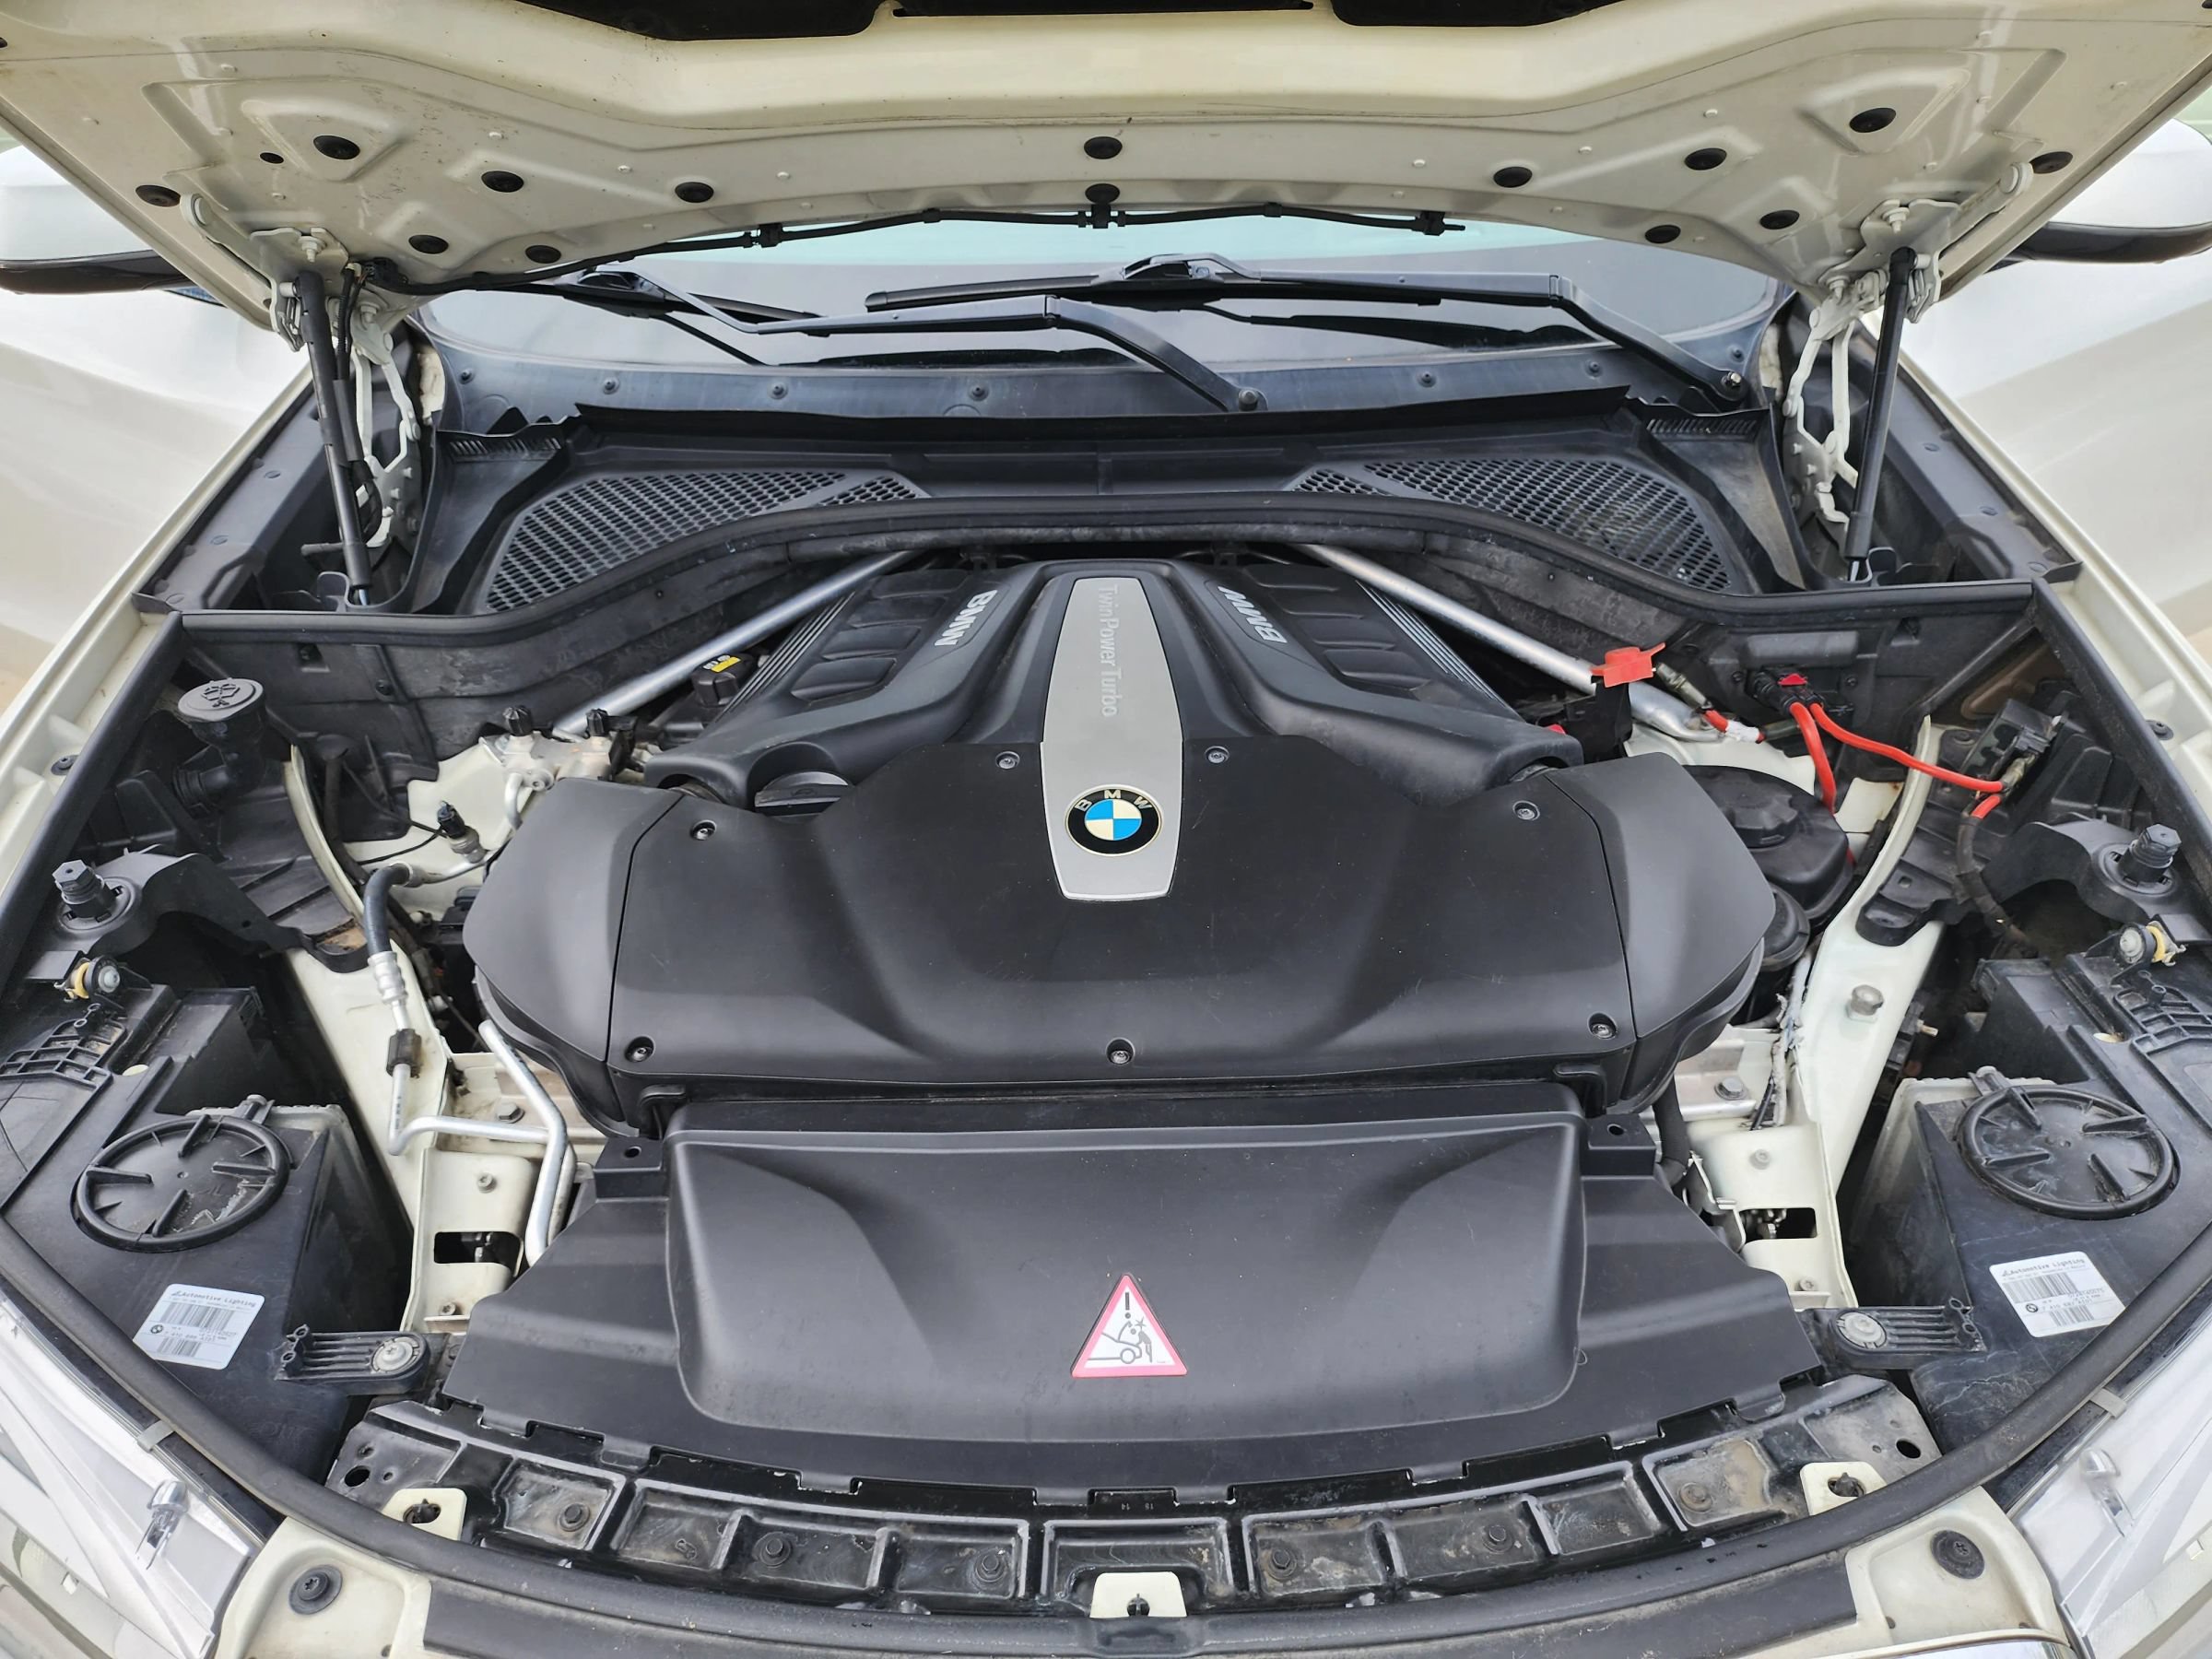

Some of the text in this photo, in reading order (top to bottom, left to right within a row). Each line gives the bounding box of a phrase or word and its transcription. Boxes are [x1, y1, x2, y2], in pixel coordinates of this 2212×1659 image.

[934, 590, 997, 646] BMW
[1218, 585, 1288, 643] BMW
[1099, 583, 1123, 717] TwinPower Turbo
[1075, 789, 1153, 811] BMW
